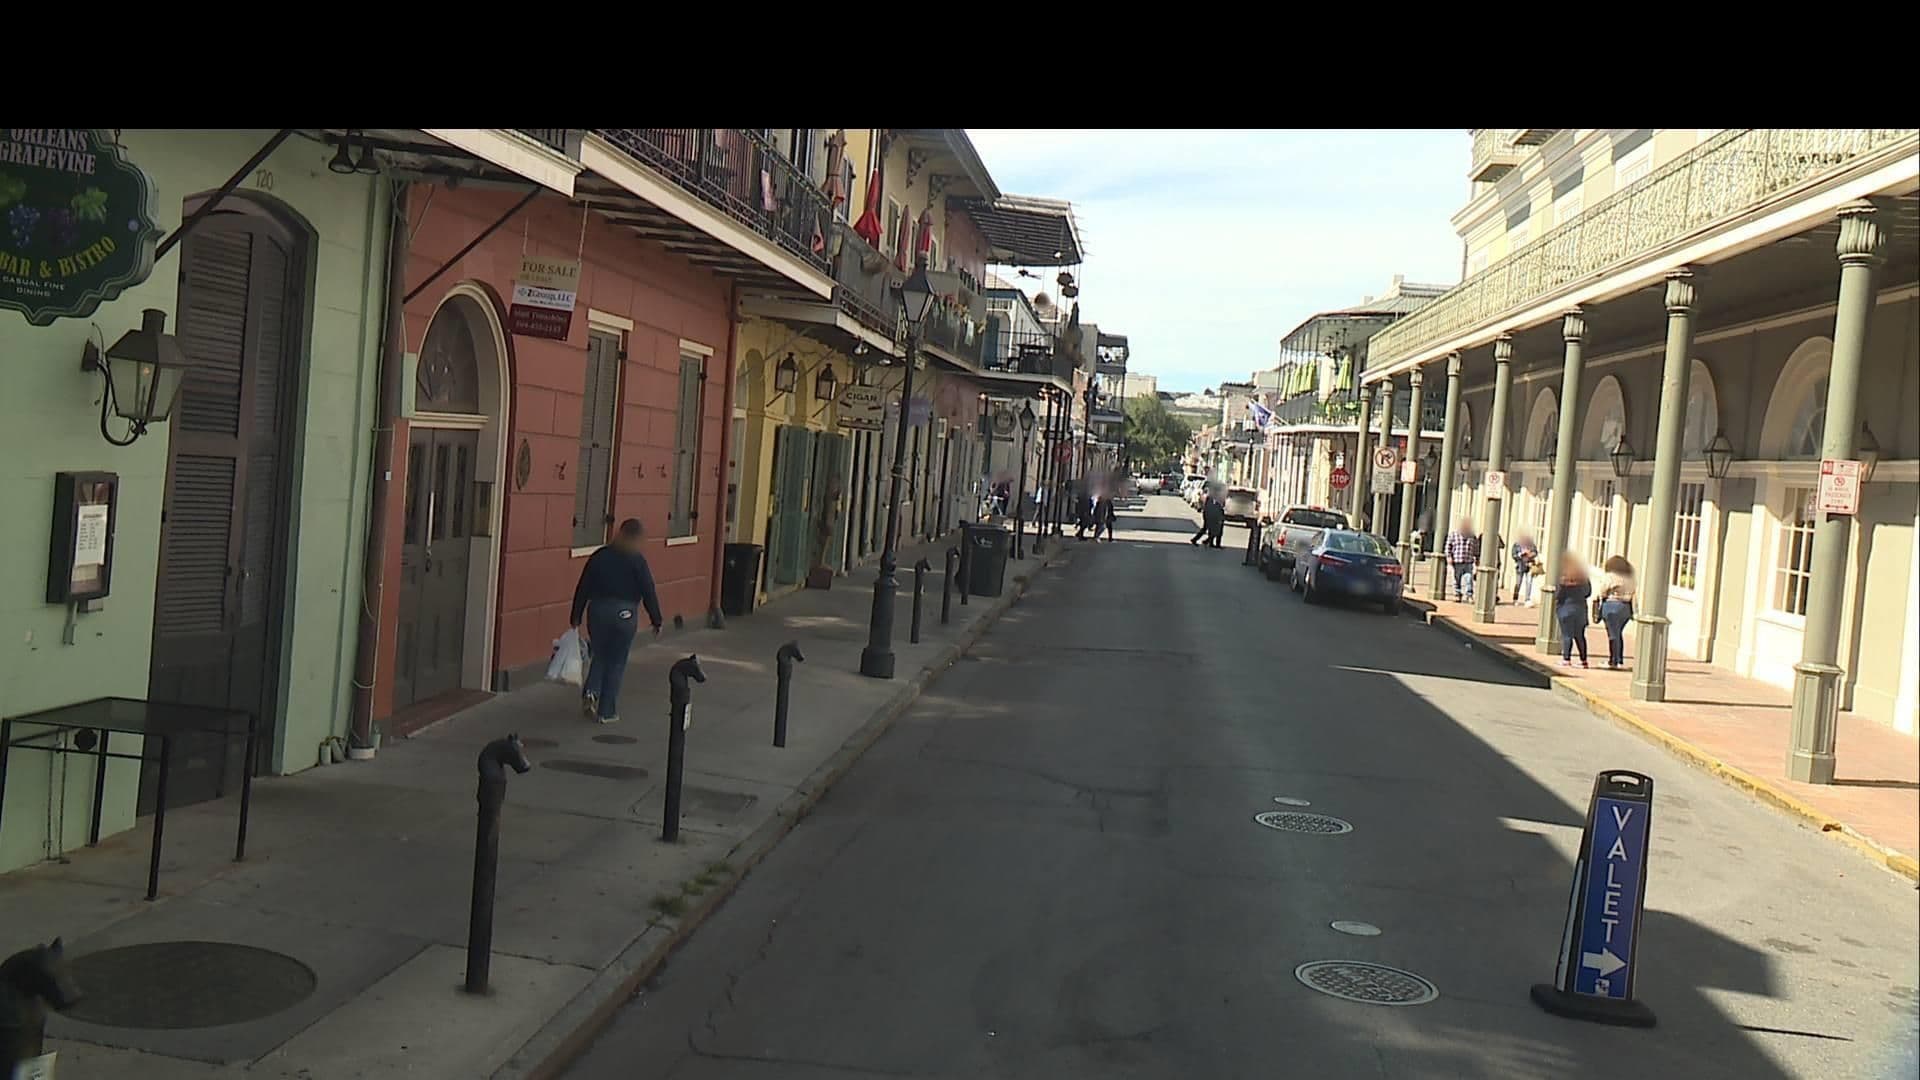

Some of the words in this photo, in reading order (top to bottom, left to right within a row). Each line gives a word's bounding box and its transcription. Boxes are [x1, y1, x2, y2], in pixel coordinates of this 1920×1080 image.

[10, 128, 90, 151] ORLEANS
[0, 141, 97, 175] GRAPEVINE
[255, 169, 274, 191] 120
[0, 252, 31, 277] BAR
[39, 260, 52, 278] &
[57, 236, 118, 276] BISTRO
[522, 262, 546, 273] FOR
[548, 263, 577, 278] SALE
[2, 275, 41, 289] CASUAL
[44, 278, 65, 291] FINE
[16, 286, 50, 297] DINING
[1331, 474, 1351, 484] STOP
[1601, 806, 1633, 943] VALET
